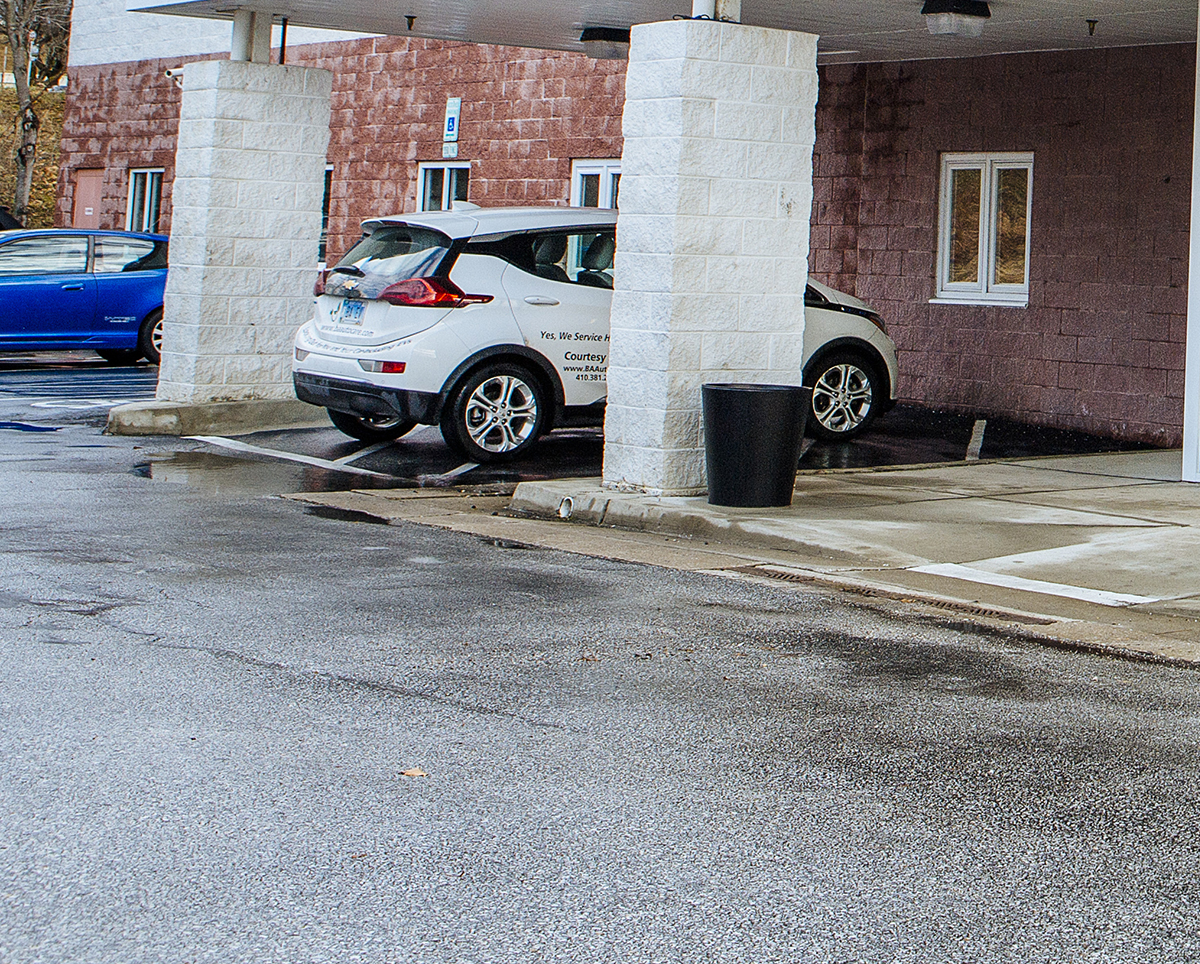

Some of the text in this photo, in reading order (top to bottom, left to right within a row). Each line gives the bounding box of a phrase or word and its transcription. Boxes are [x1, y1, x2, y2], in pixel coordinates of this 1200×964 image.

[540, 330, 556, 341] Yes,
[559, 331, 573, 341] We
[573, 332, 603, 342] Service
[564, 351, 607, 364] Courtesy
